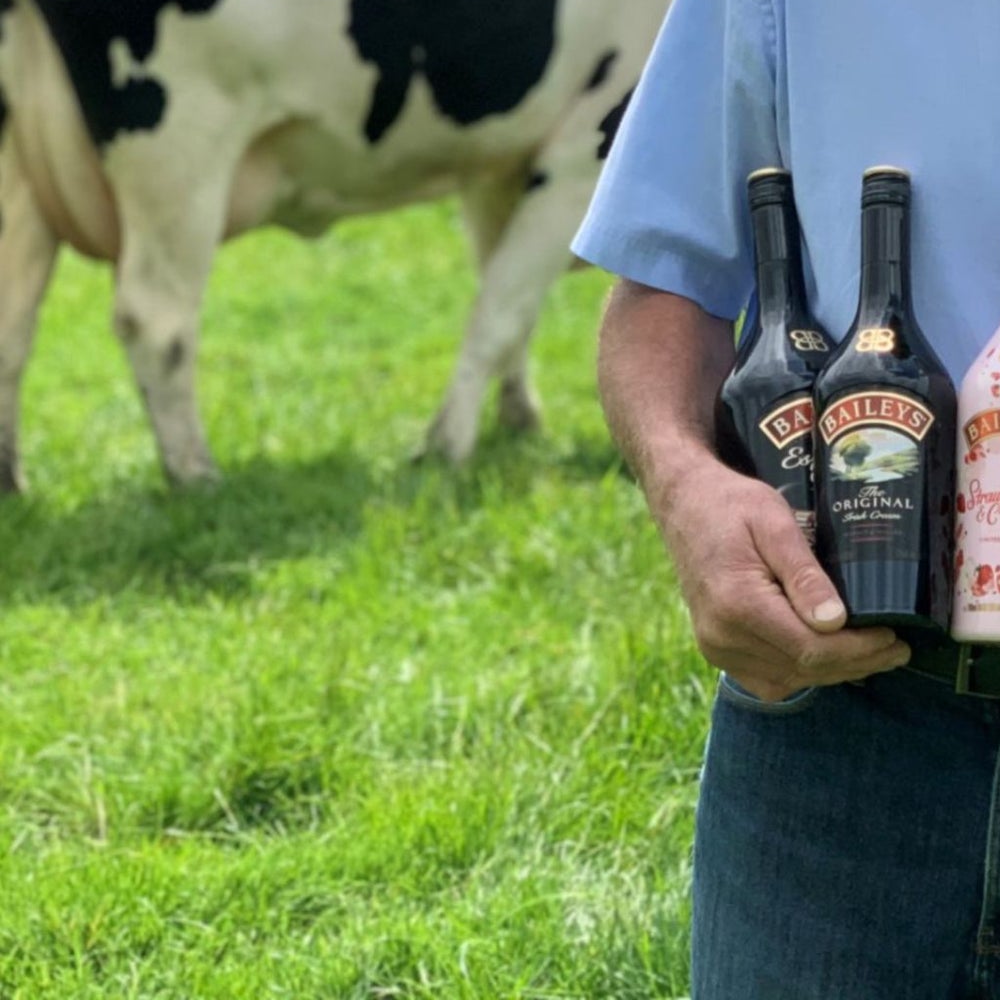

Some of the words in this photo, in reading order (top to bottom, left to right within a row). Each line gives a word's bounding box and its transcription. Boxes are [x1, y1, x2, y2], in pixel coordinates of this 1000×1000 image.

[771, 409, 814, 437] BA
[824, 398, 922, 434] BAILEYS
[858, 485, 886, 498] The
[832, 497, 914, 512] ORIGINAL
